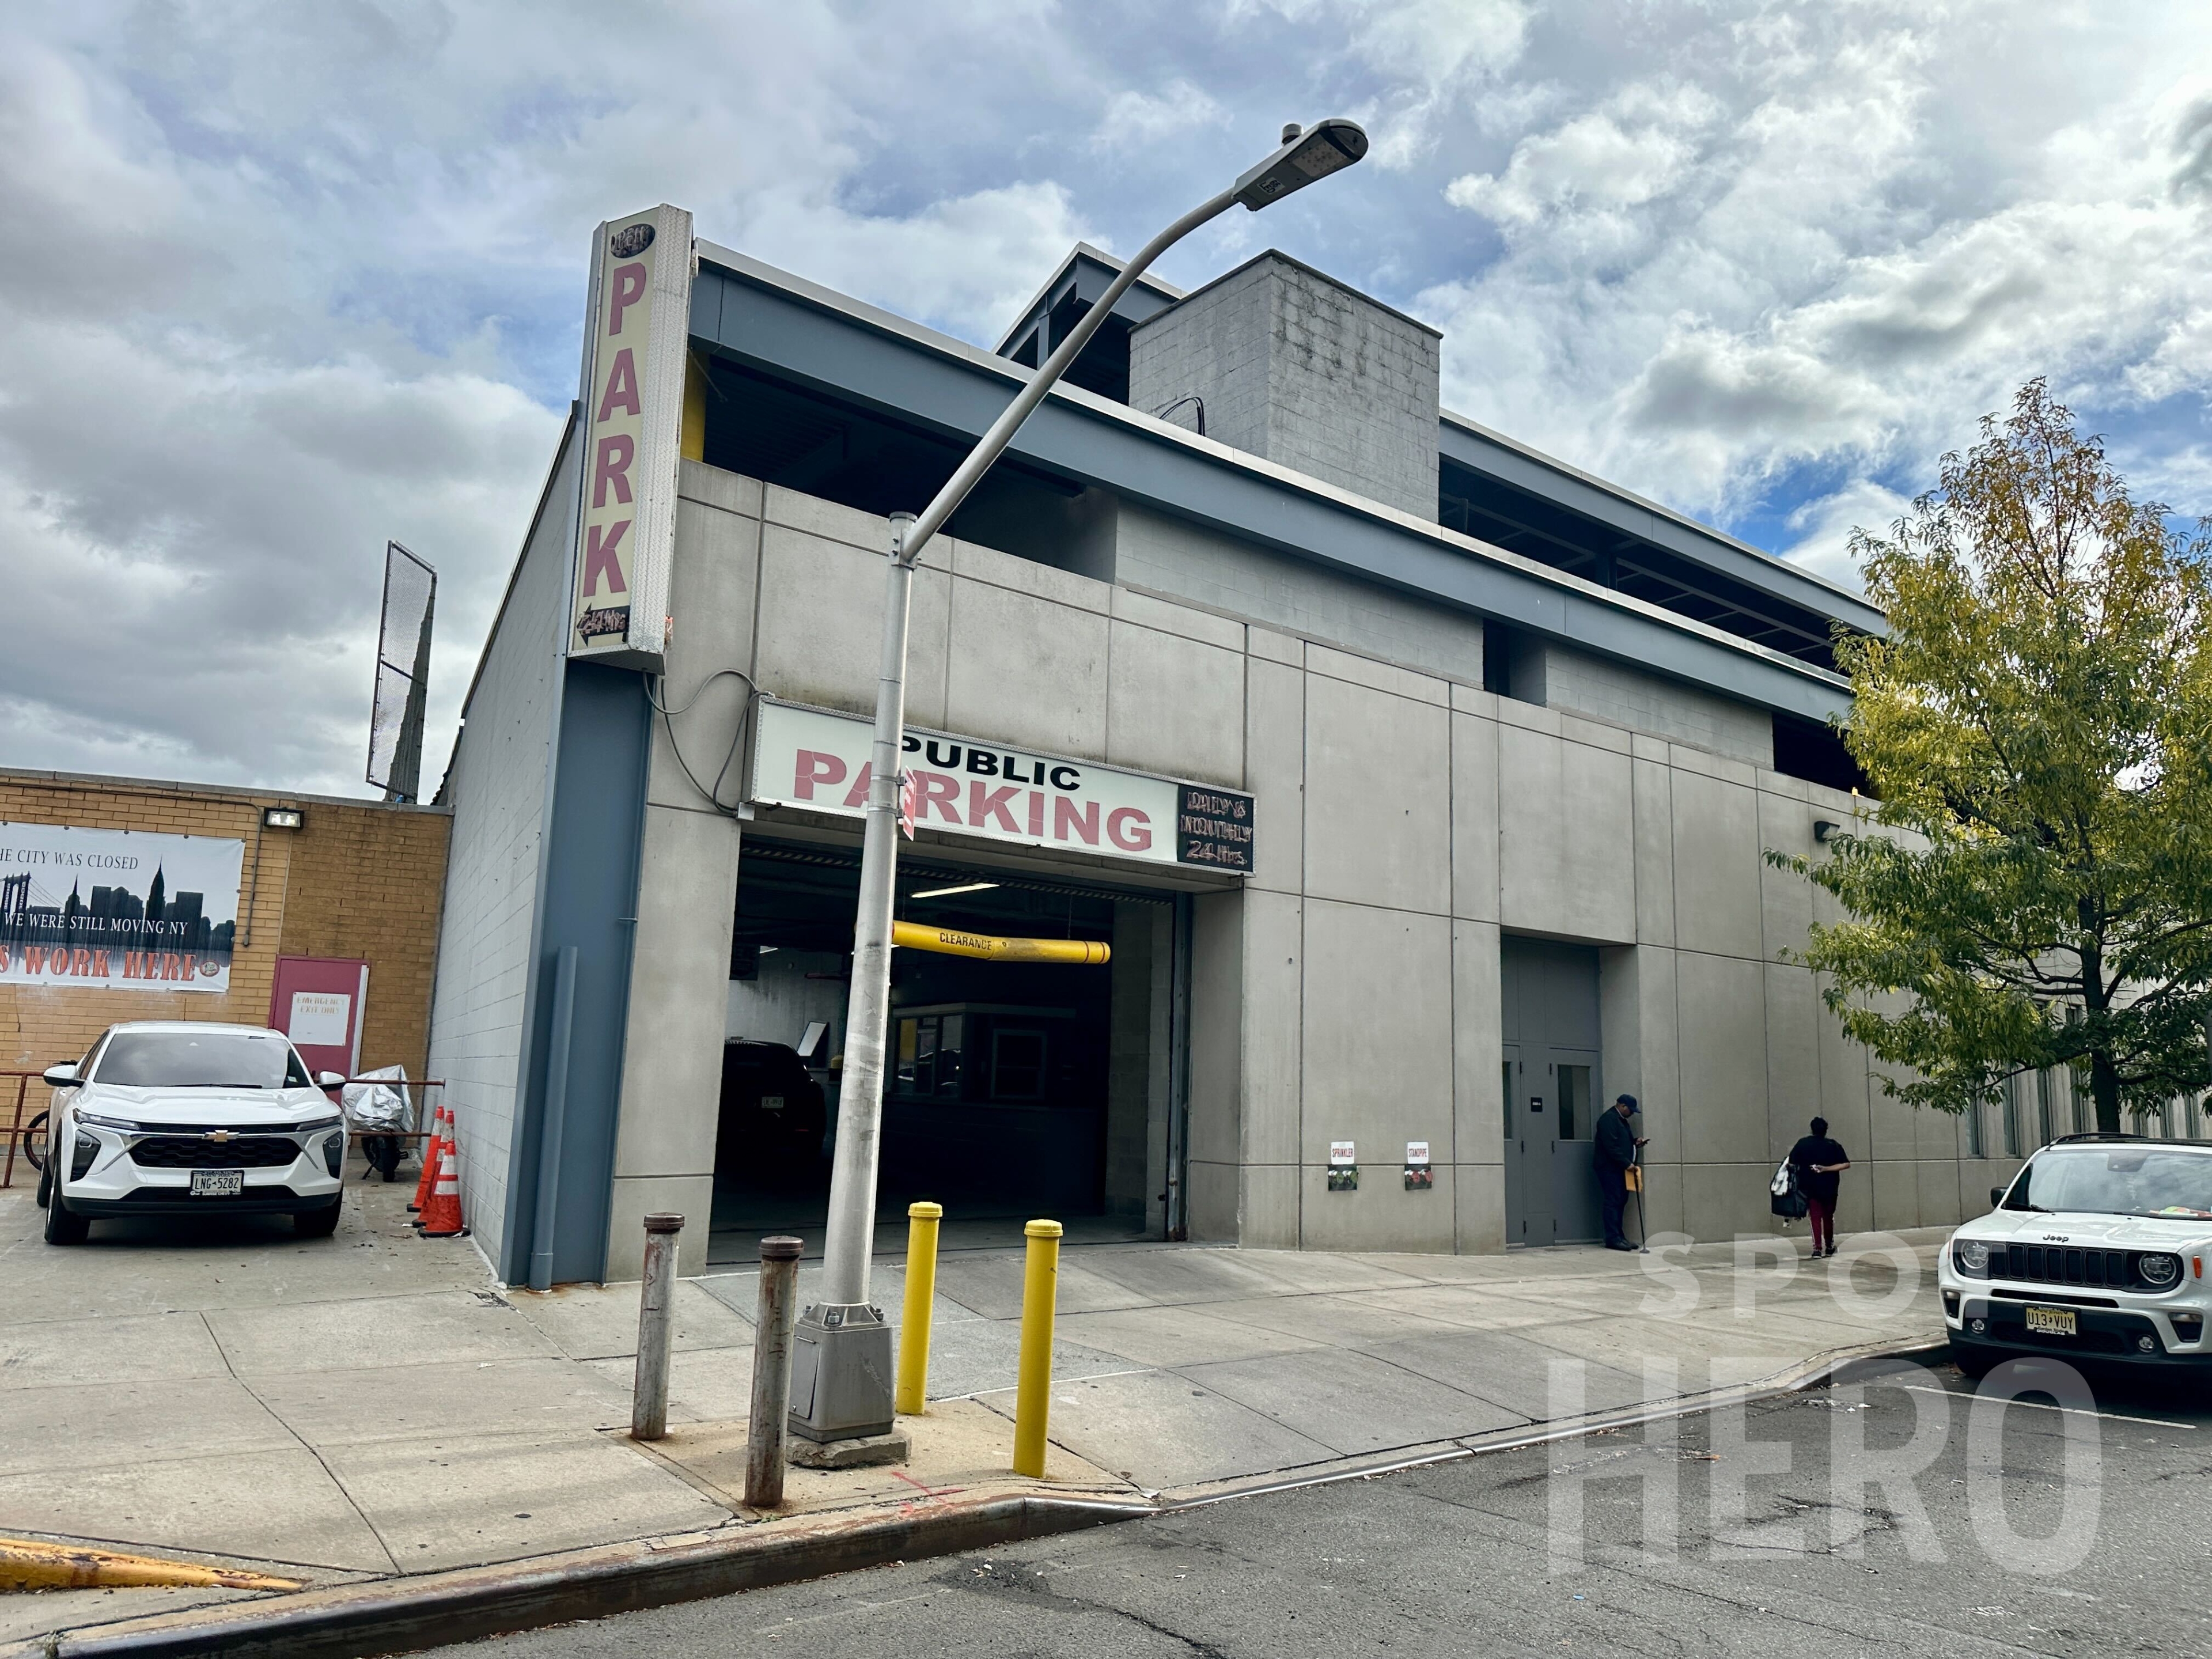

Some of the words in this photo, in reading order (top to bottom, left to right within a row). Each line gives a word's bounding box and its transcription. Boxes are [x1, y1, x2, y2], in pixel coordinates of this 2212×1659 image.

[1259, 181, 1275, 193] LED
[582, 262, 646, 597] PARK
[1180, 815, 1252, 843] MONTHLY
[1186, 840, 1214, 859] 24
[17, 849, 49, 863] CITY
[55, 852, 82, 866] WAS
[88, 854, 138, 870] CLOSED
[5, 912, 24, 926] WE
[29, 914, 65, 929] WERE
[70, 916, 105, 931] STILL
[110, 918, 164, 934] MOVING
[169, 921, 188, 935] NY
[940, 932, 992, 950] CLEARANCE
[24, 946, 111, 978] WORK
[122, 951, 197, 982] HERE
[1332, 1148, 1353, 1158] SPRINKLER
[1409, 1149, 1427, 1157] STANDPIPE
[2043, 1234, 2069, 1243] Jeep
